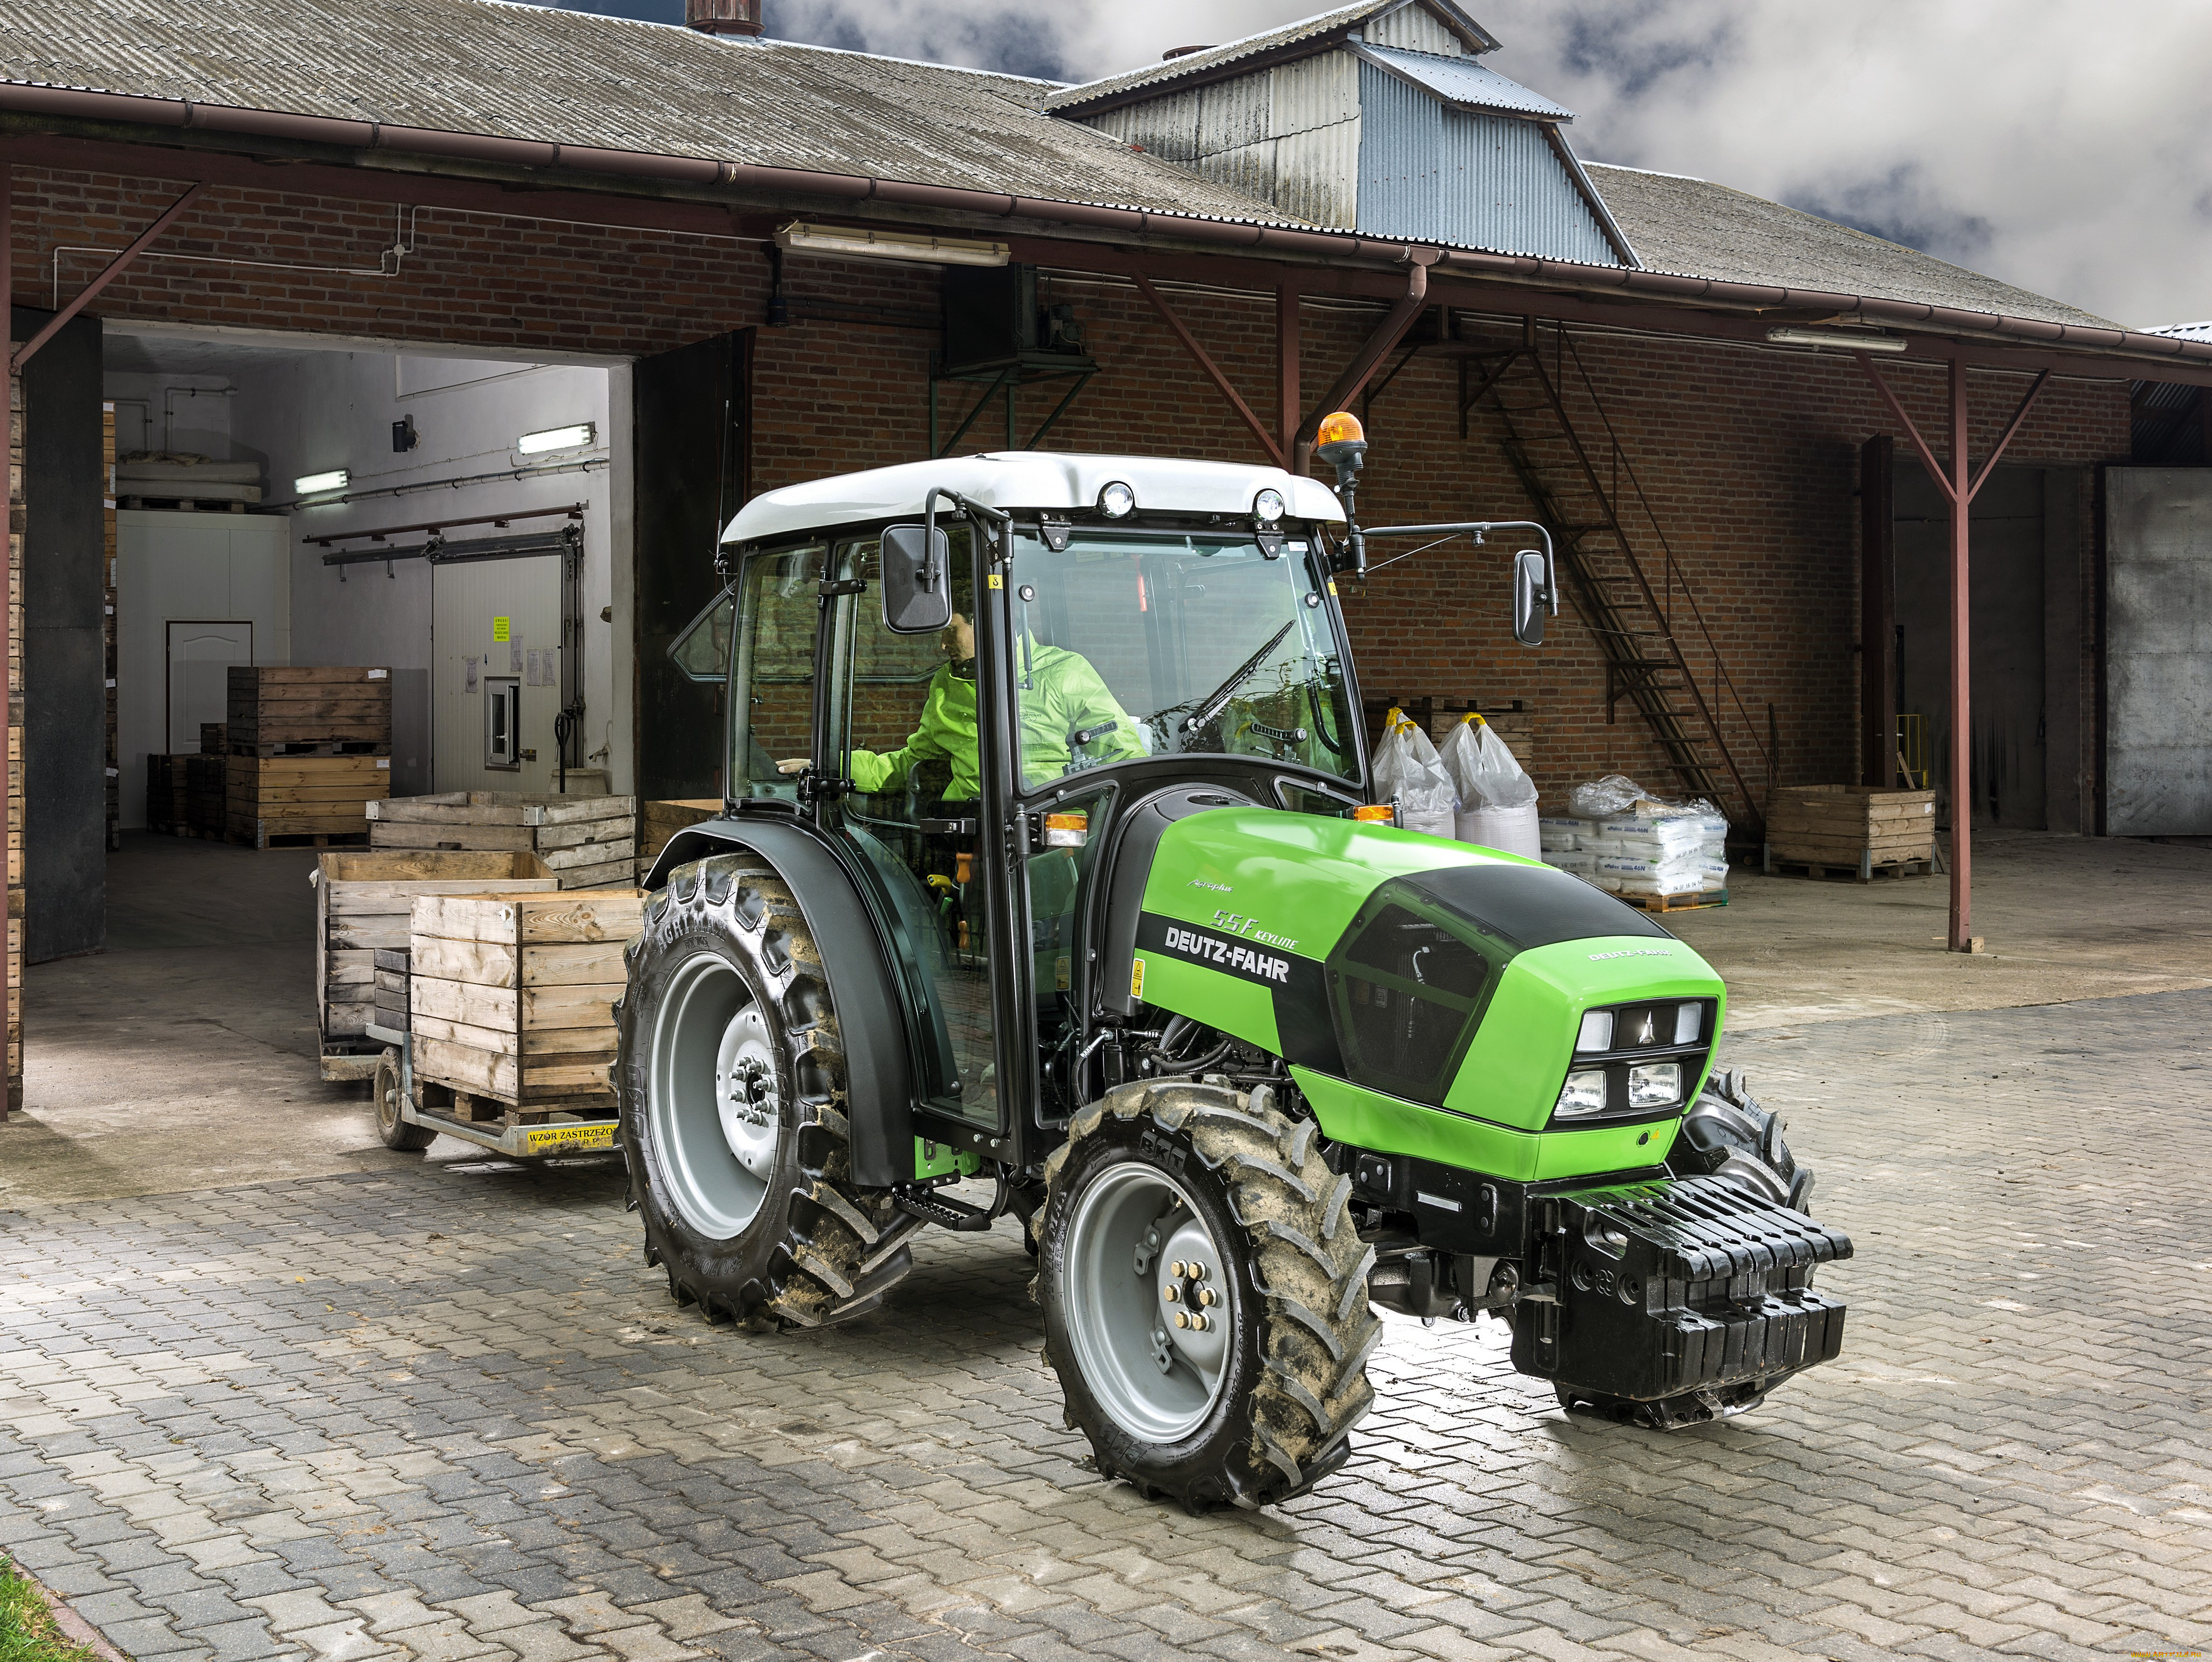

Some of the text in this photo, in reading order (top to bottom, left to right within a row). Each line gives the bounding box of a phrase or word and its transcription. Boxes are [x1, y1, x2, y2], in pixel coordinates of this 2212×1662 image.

[1187, 879, 1234, 893] Agroplus
[1255, 930, 1299, 950] KEYLINE
[1165, 926, 1289, 983] DEUTZ-FAHR
[1587, 950, 1672, 961] DEUTZ-FAHR
[624, 1065, 642, 1137] BKT
[529, 1131, 557, 1142] WZÓR
[1139, 1132, 1186, 1174] BKT
